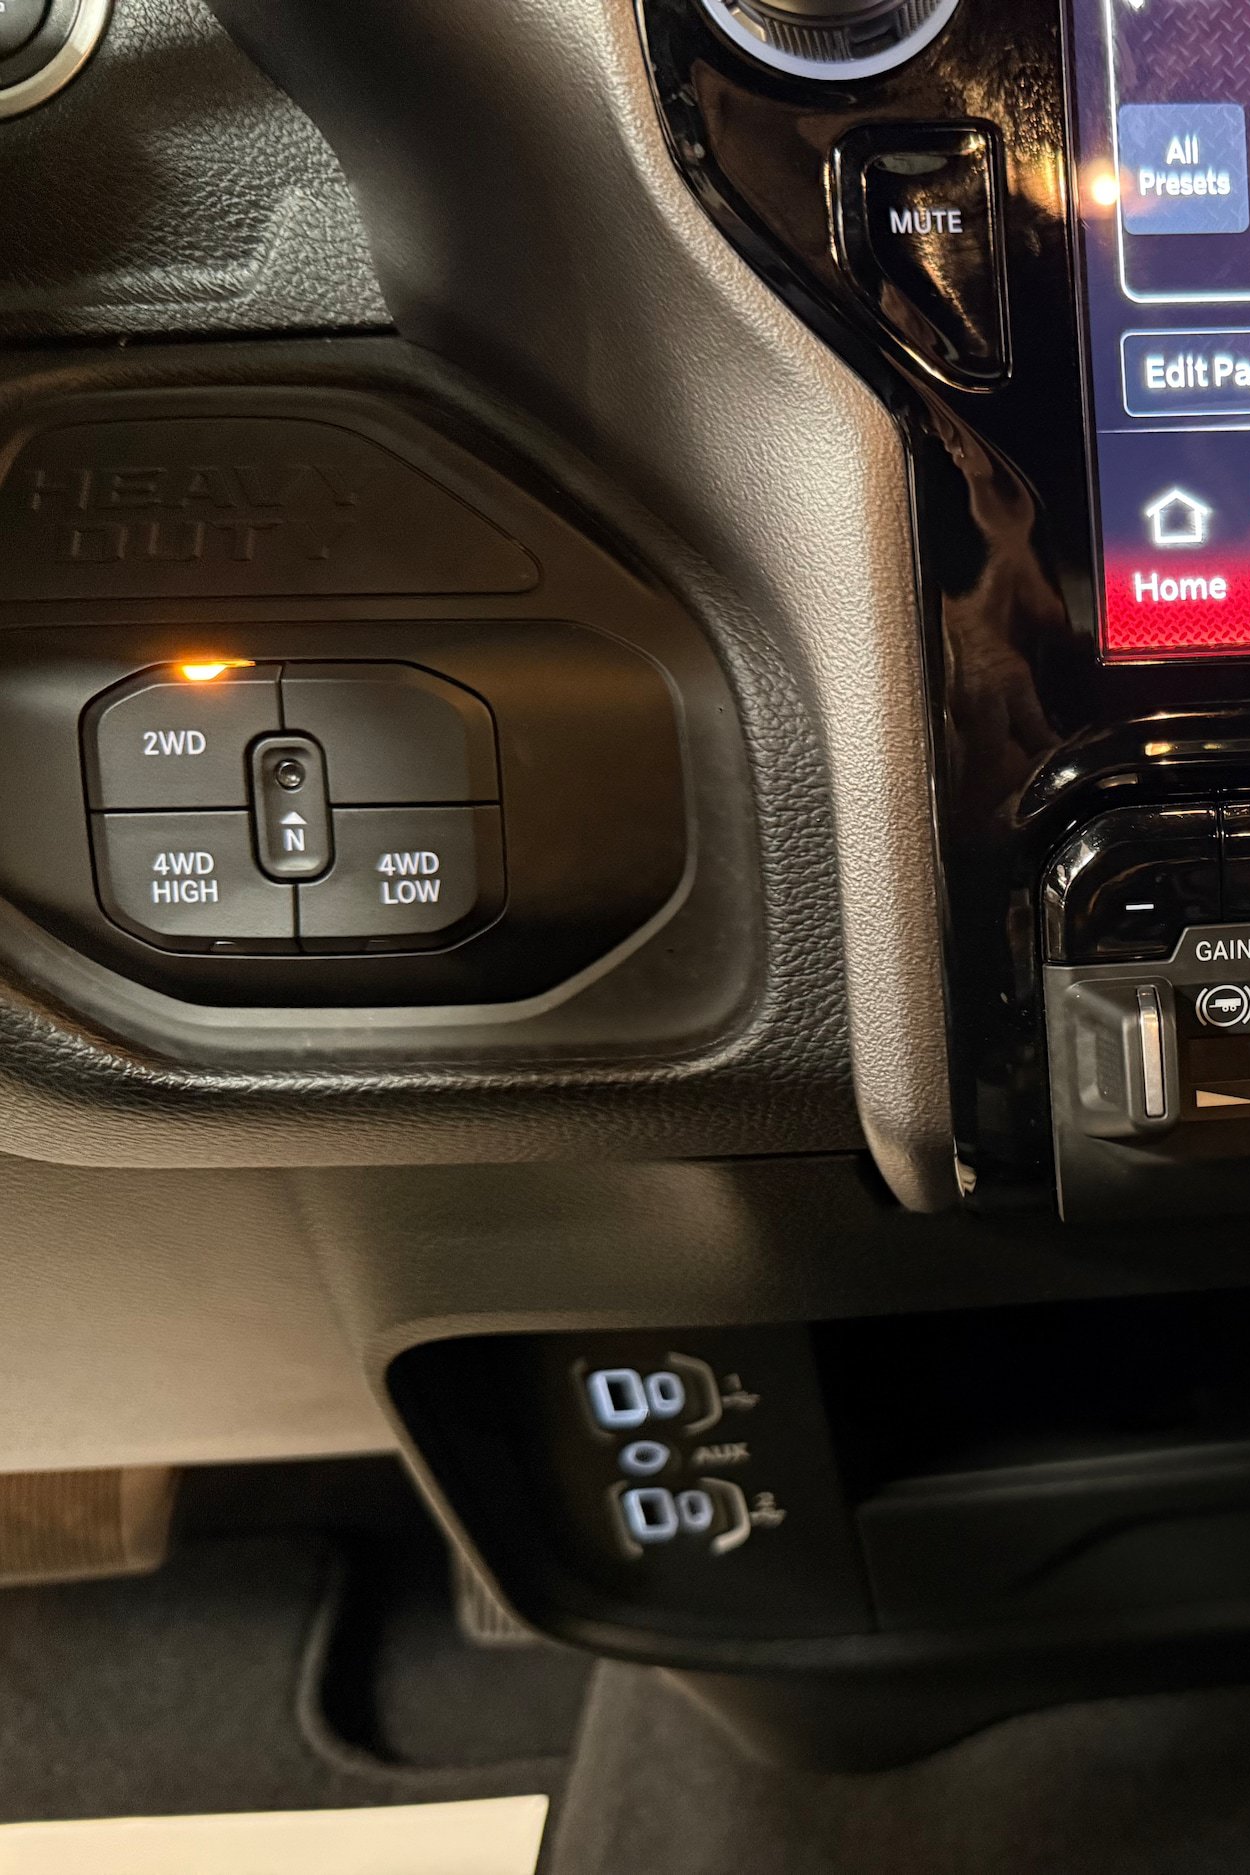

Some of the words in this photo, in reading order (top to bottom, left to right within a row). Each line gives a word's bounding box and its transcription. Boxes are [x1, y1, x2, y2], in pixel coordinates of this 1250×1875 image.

[1166, 133, 1198, 165] All
[1139, 168, 1231, 196] Presets
[889, 206, 963, 234] MUTE
[1146, 354, 1209, 388] Edit
[25, 464, 385, 511] HEAVY
[55, 517, 358, 563] DUTY
[1133, 572, 1227, 603] Home
[143, 730, 207, 756] 2WD
[283, 829, 305, 851] N
[153, 852, 214, 875] 4WD
[377, 852, 440, 875] 4WD
[151, 879, 219, 903] HIGH
[381, 880, 441, 904] LOW
